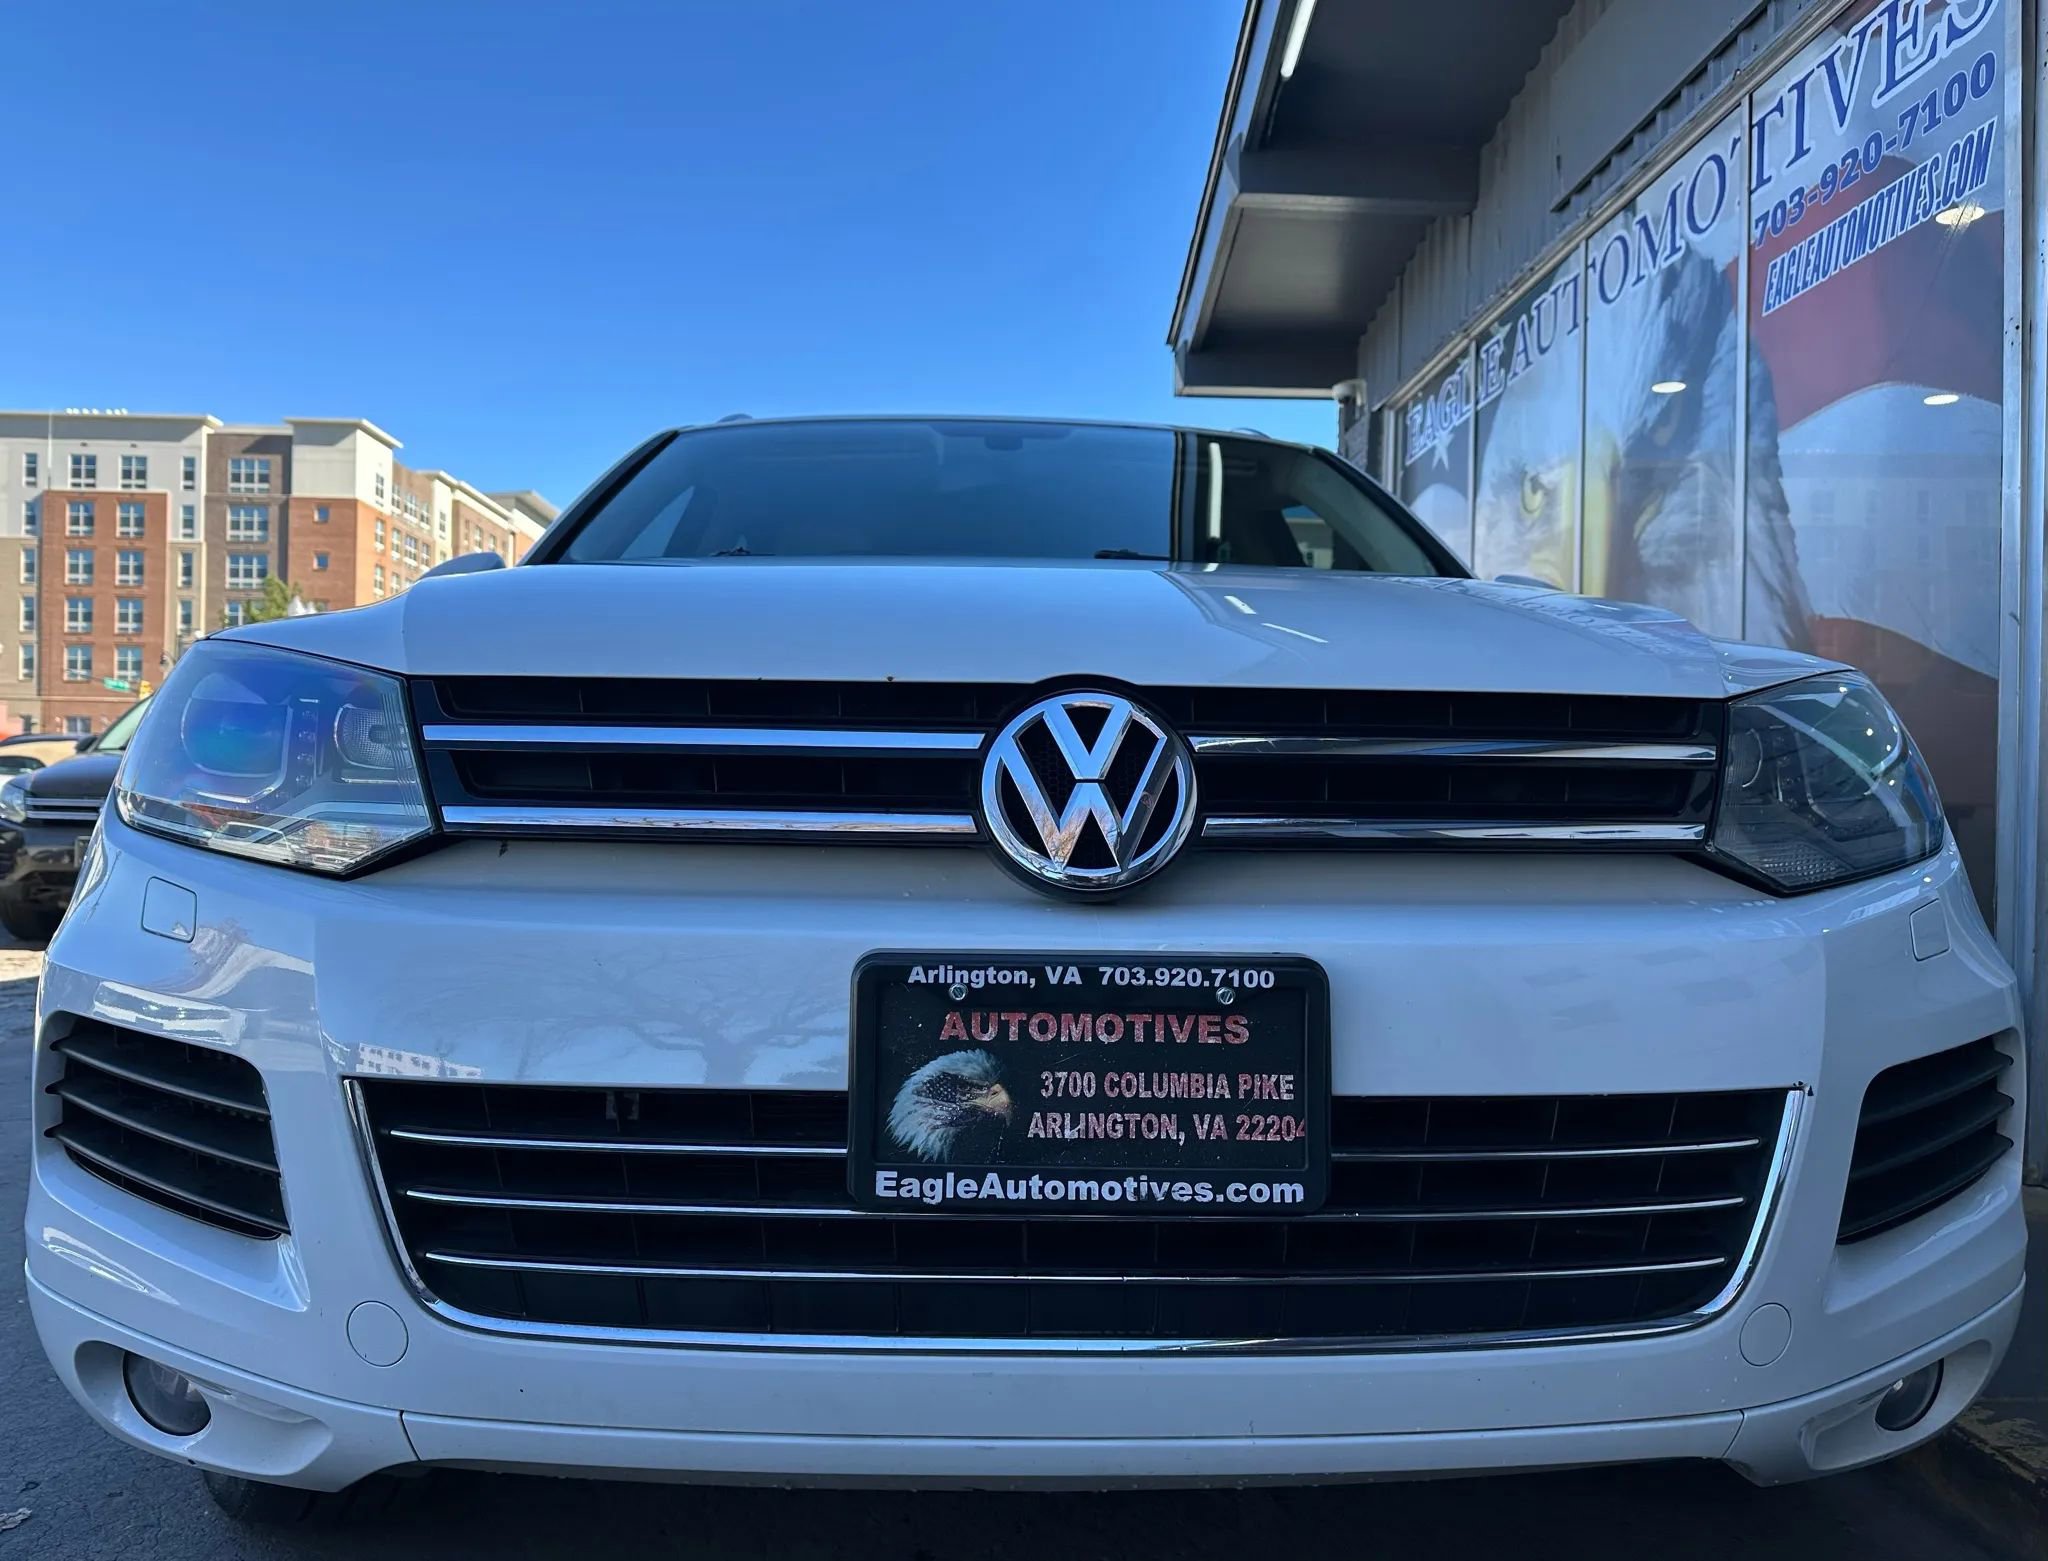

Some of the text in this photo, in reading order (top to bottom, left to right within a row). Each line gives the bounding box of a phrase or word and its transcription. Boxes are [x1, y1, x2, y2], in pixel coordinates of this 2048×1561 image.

[1755, 50, 1997, 250] 703-920-7100
[1762, 116, 1998, 317] EAGLEAUTOMOTIVES.COM
[1406, 334, 1507, 465] EAGLE
[908, 966, 1276, 989] Arlington, VA 703.920.7100
[939, 1011, 1250, 1045] AUTOMOTIVES
[1040, 1071, 1295, 1101] 3700 COLUMBIA PIKE
[1027, 1112, 1186, 1146] ARLINGTON,
[1192, 1113, 1229, 1141] VA
[875, 1170, 1305, 1205] EagleAutomotives.com
